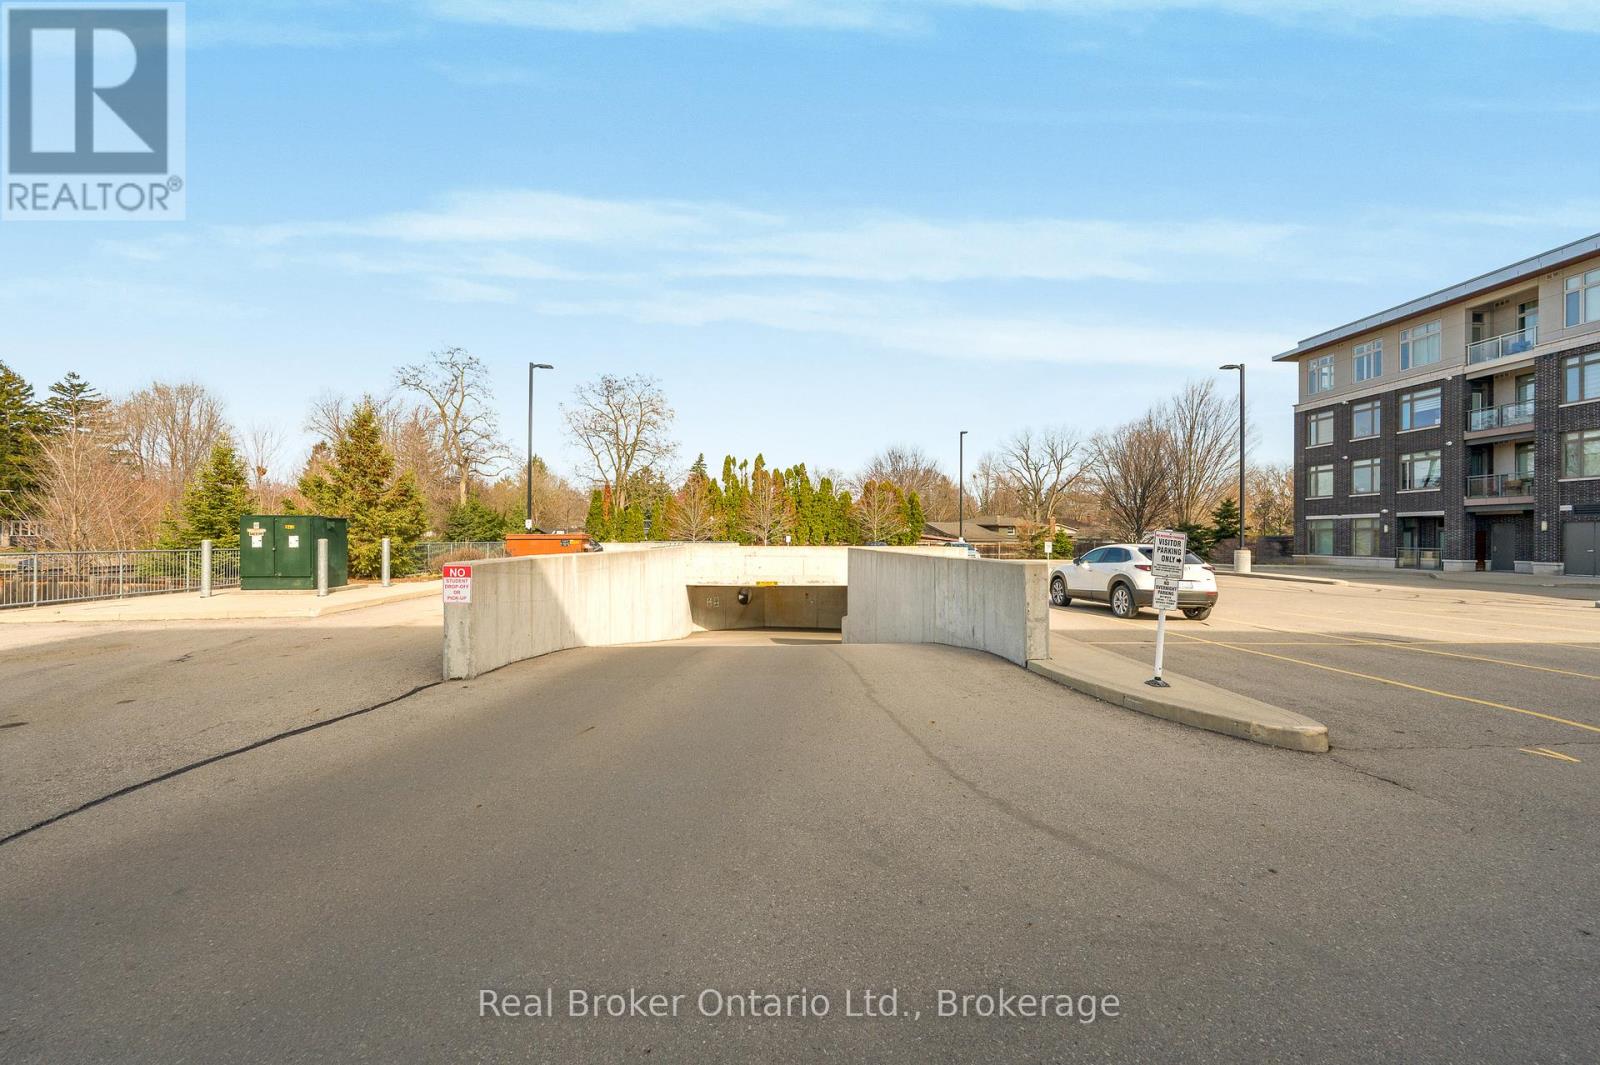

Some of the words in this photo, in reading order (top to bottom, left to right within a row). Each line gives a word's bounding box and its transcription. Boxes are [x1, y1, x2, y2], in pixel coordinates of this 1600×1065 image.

[1158, 538, 1182, 548] VISITOR
[1156, 546, 1182, 556] PARKING
[1161, 555, 1176, 563] ONLY
[449, 568, 466, 577] NO
